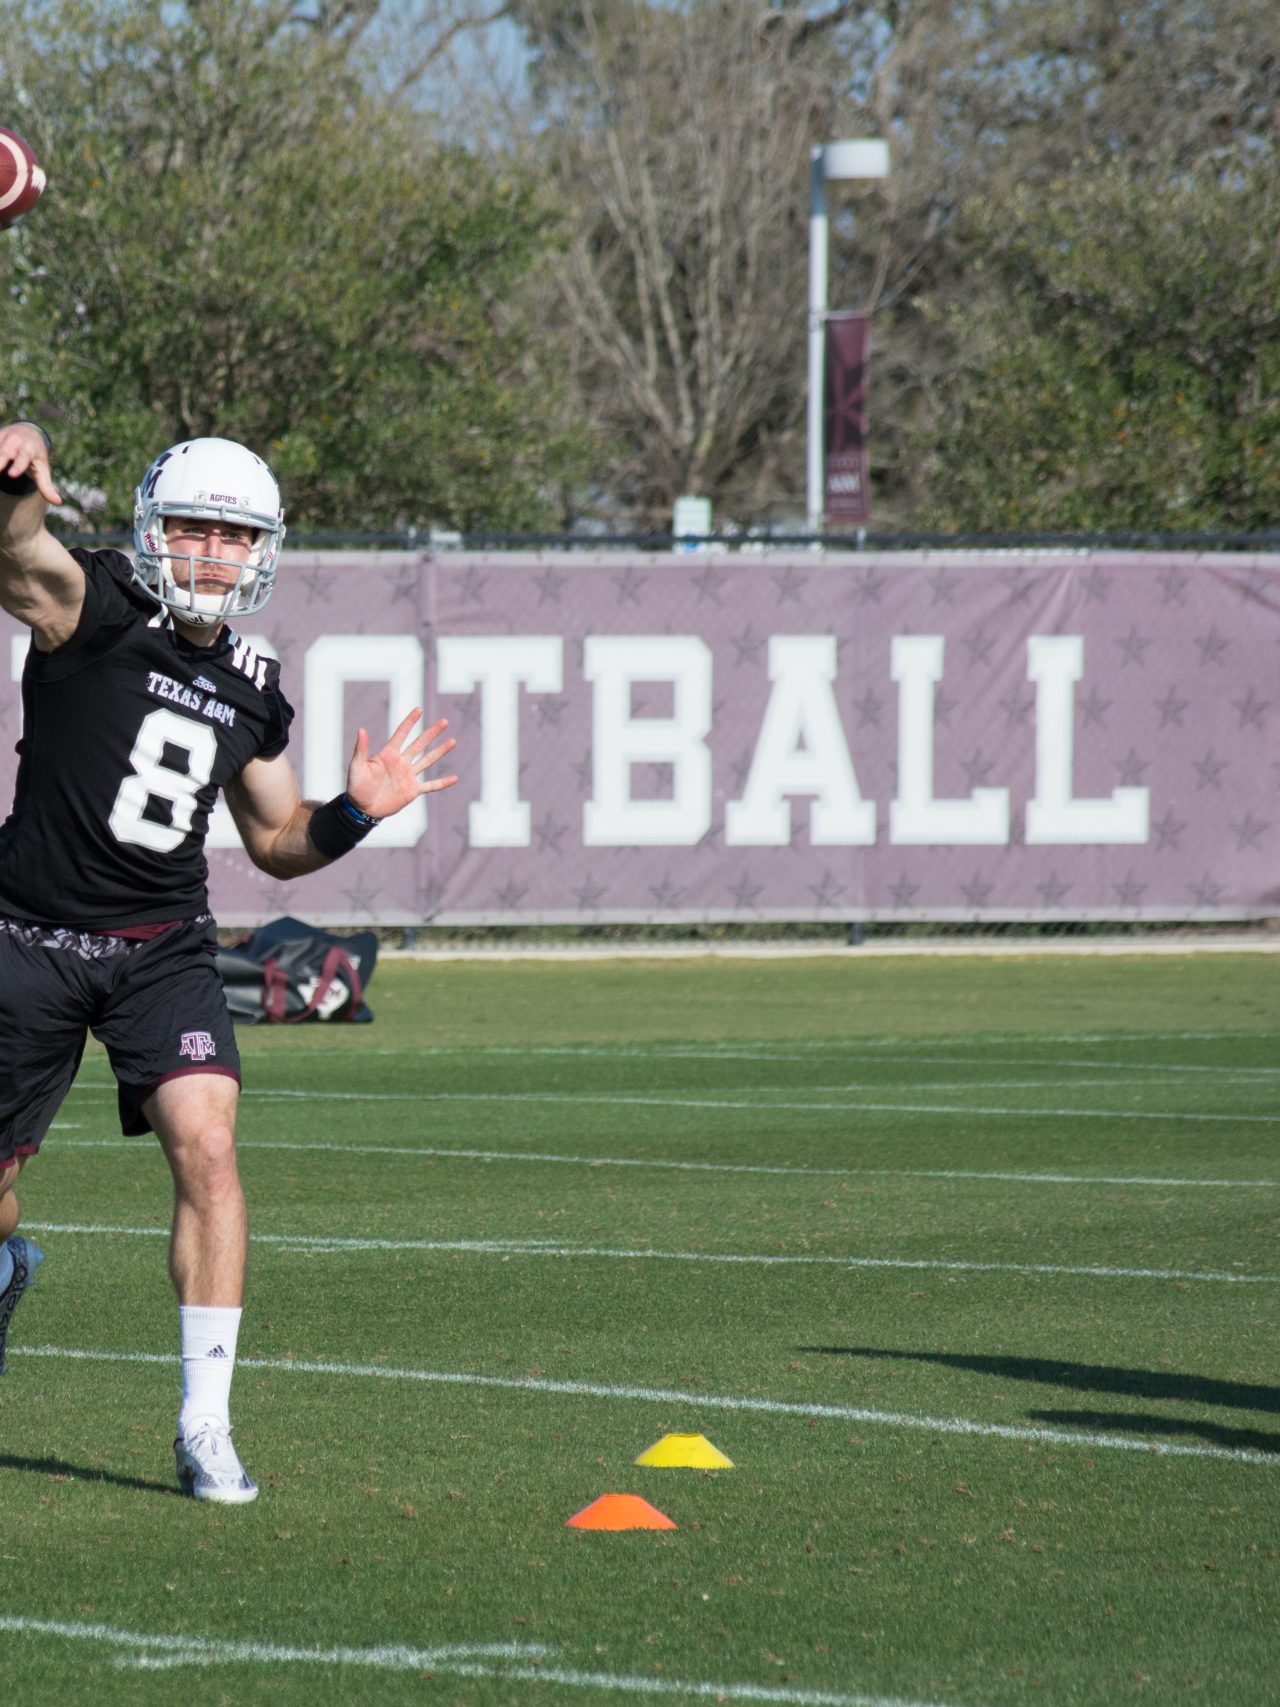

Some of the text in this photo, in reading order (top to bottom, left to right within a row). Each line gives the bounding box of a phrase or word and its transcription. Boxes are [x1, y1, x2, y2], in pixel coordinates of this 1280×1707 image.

[209, 493, 237, 505] AGGIES
[146, 671, 236, 727] TEXAS A&M
[192, 678, 217, 693] adidas
[11, 634, 1150, 845] OTBALL
[107, 707, 218, 853] 8
